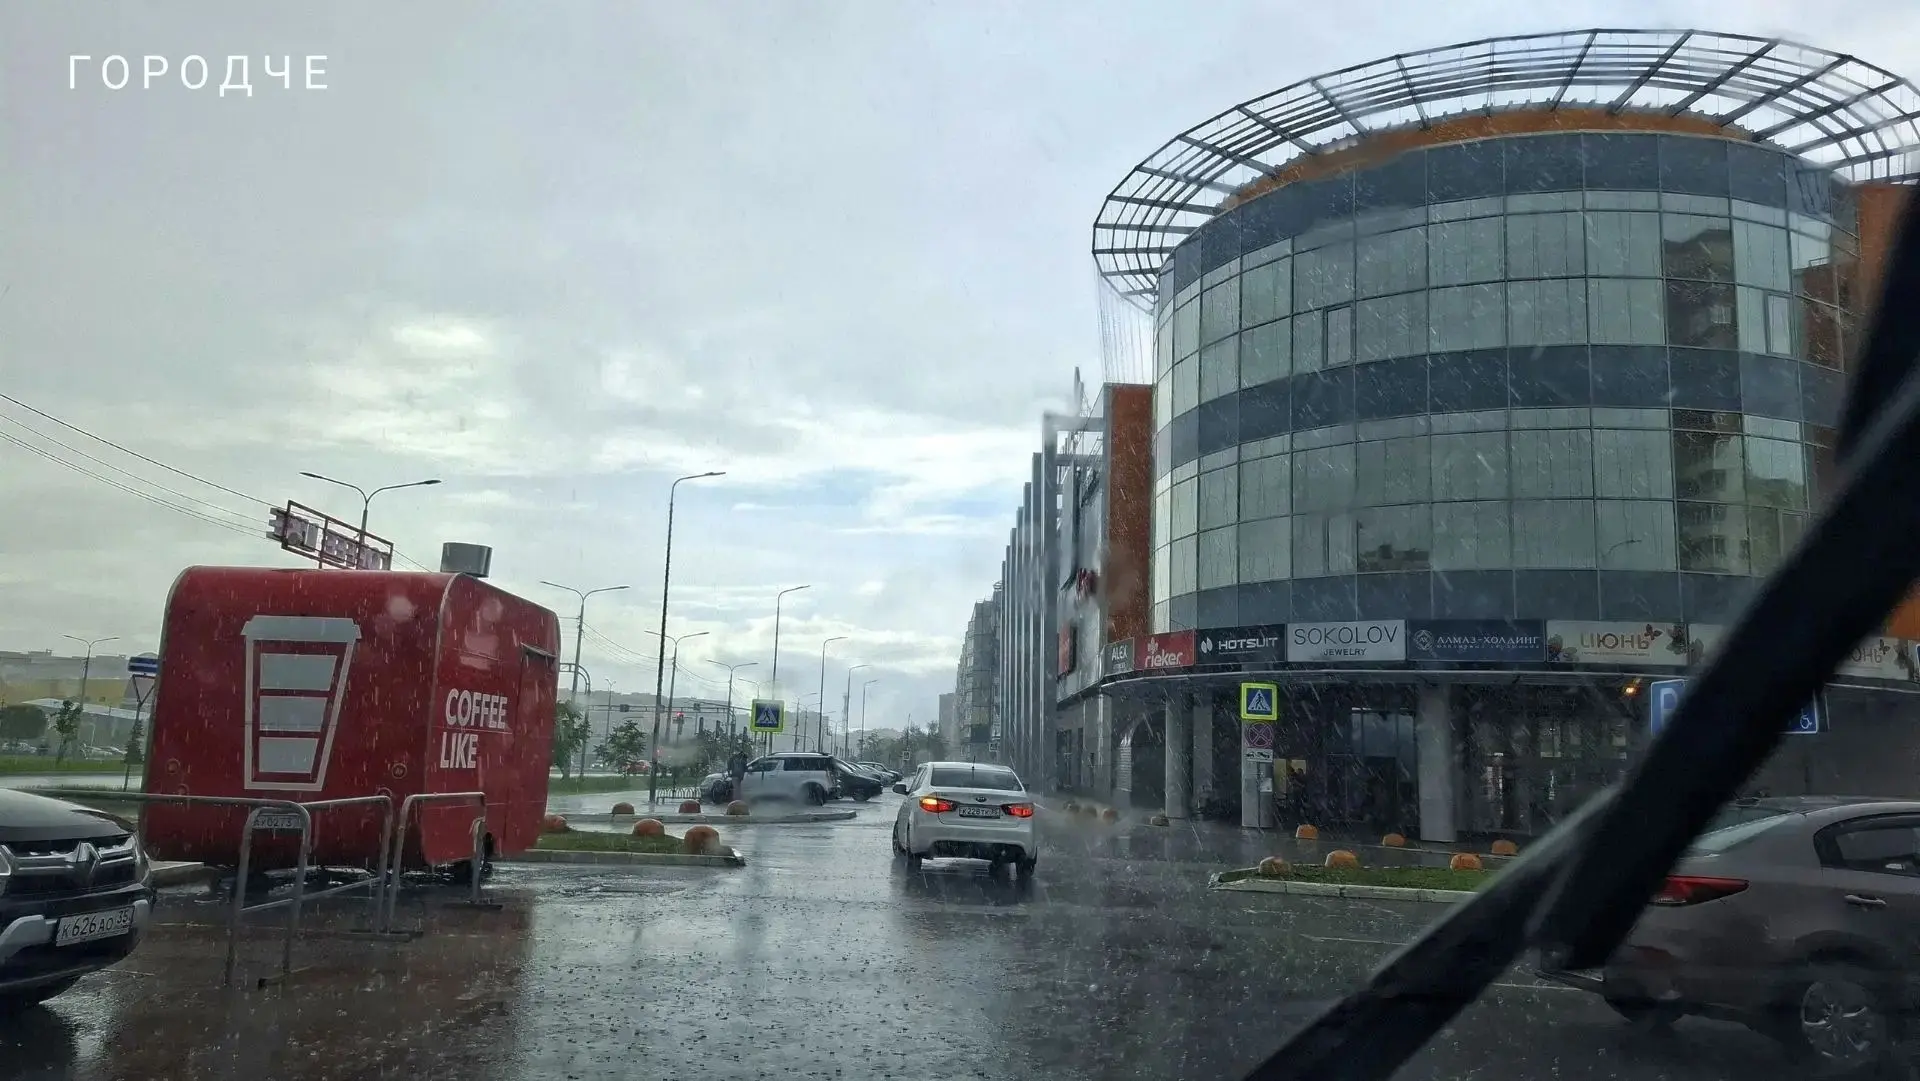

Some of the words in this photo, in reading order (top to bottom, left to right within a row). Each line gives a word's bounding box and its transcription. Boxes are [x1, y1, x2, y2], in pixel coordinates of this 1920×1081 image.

[1219, 637, 1278, 650] HOTSUIT
[1294, 625, 1398, 645] SOKOLOV
[1111, 644, 1128, 661] ALEX
[1145, 649, 1184, 668] rieker
[1323, 648, 1367, 656] JEWELRY
[445, 687, 508, 729] COFFEE
[440, 731, 478, 769] LIKE
